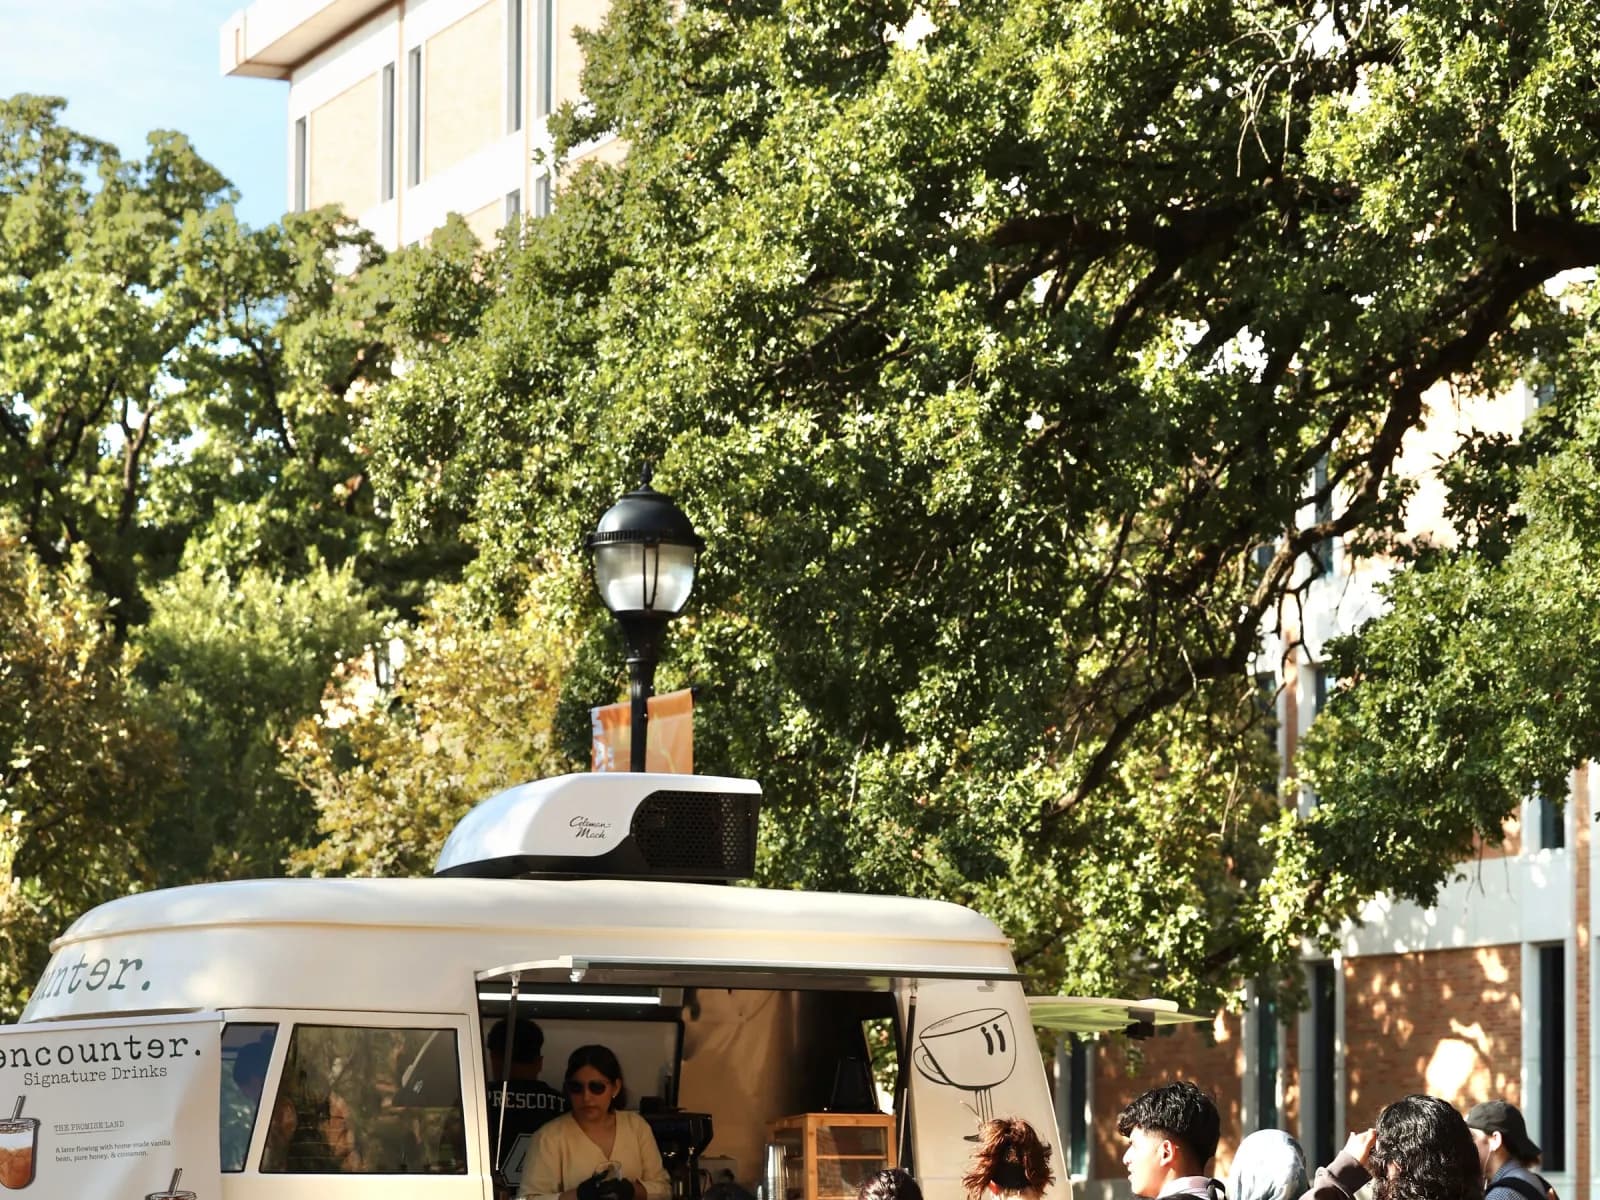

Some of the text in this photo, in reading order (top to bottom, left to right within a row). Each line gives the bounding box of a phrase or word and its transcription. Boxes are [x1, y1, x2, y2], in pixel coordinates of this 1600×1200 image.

[24, 1065, 167, 1087] Signature Drinks
[54, 1124, 69, 1132] THE
[105, 1121, 124, 1129] LAND
